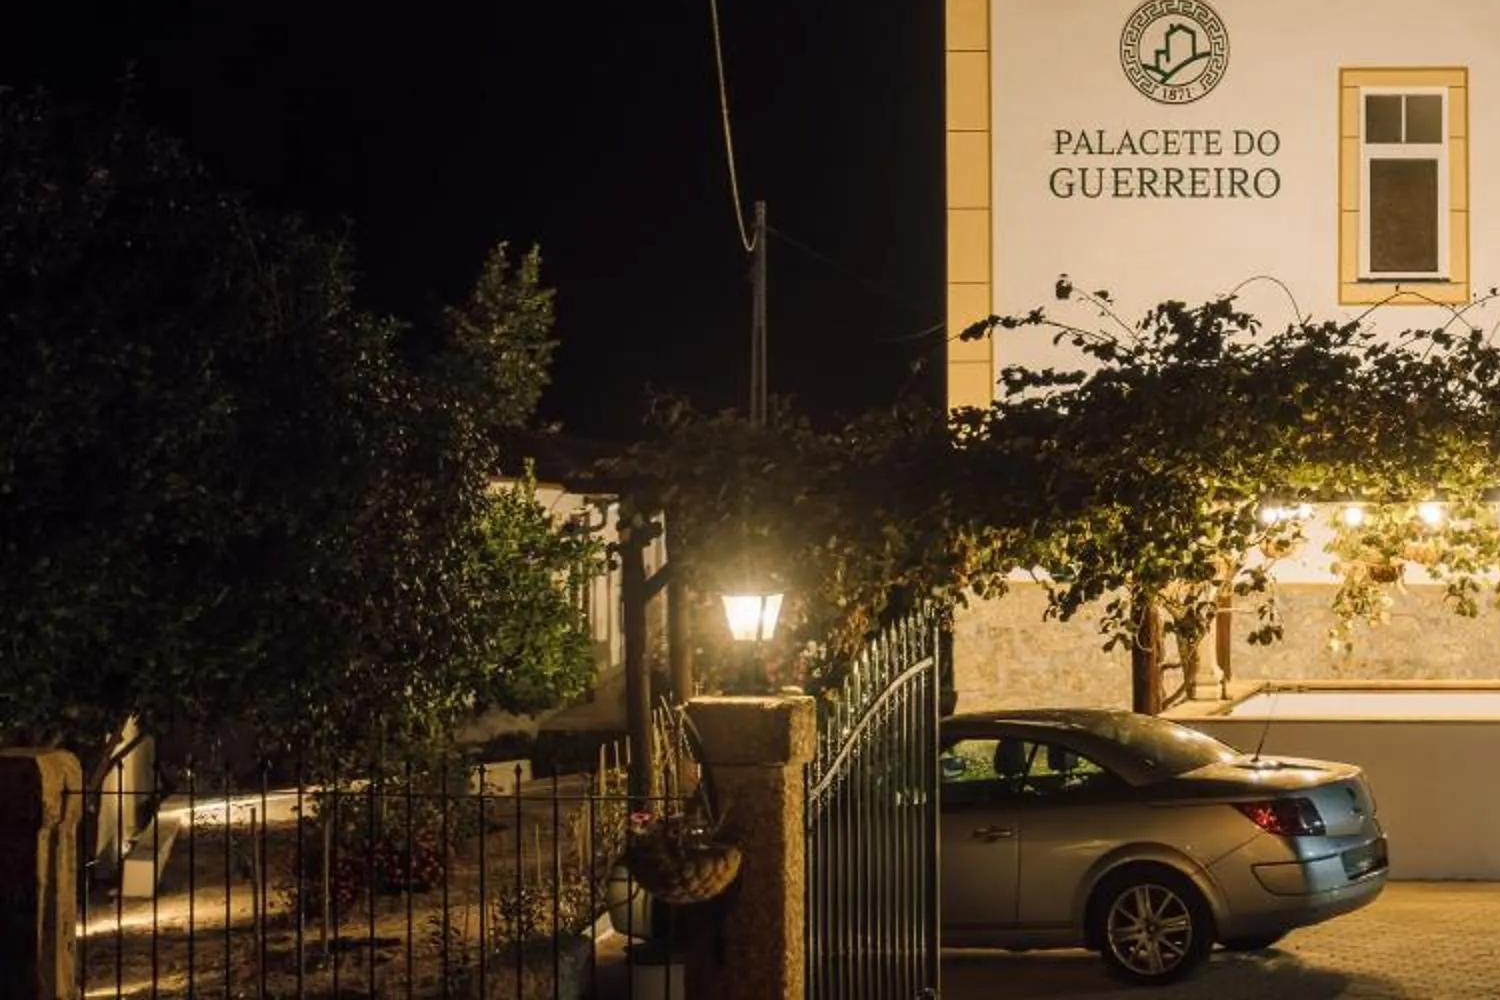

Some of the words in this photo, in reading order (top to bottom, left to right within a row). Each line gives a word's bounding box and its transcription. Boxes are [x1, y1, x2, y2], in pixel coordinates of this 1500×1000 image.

[1162, 86, 1192, 101] 1871
[1054, 129, 1223, 156] PALACETE
[1233, 129, 1281, 156] DO
[1049, 166, 1281, 199] GUERREIRO
